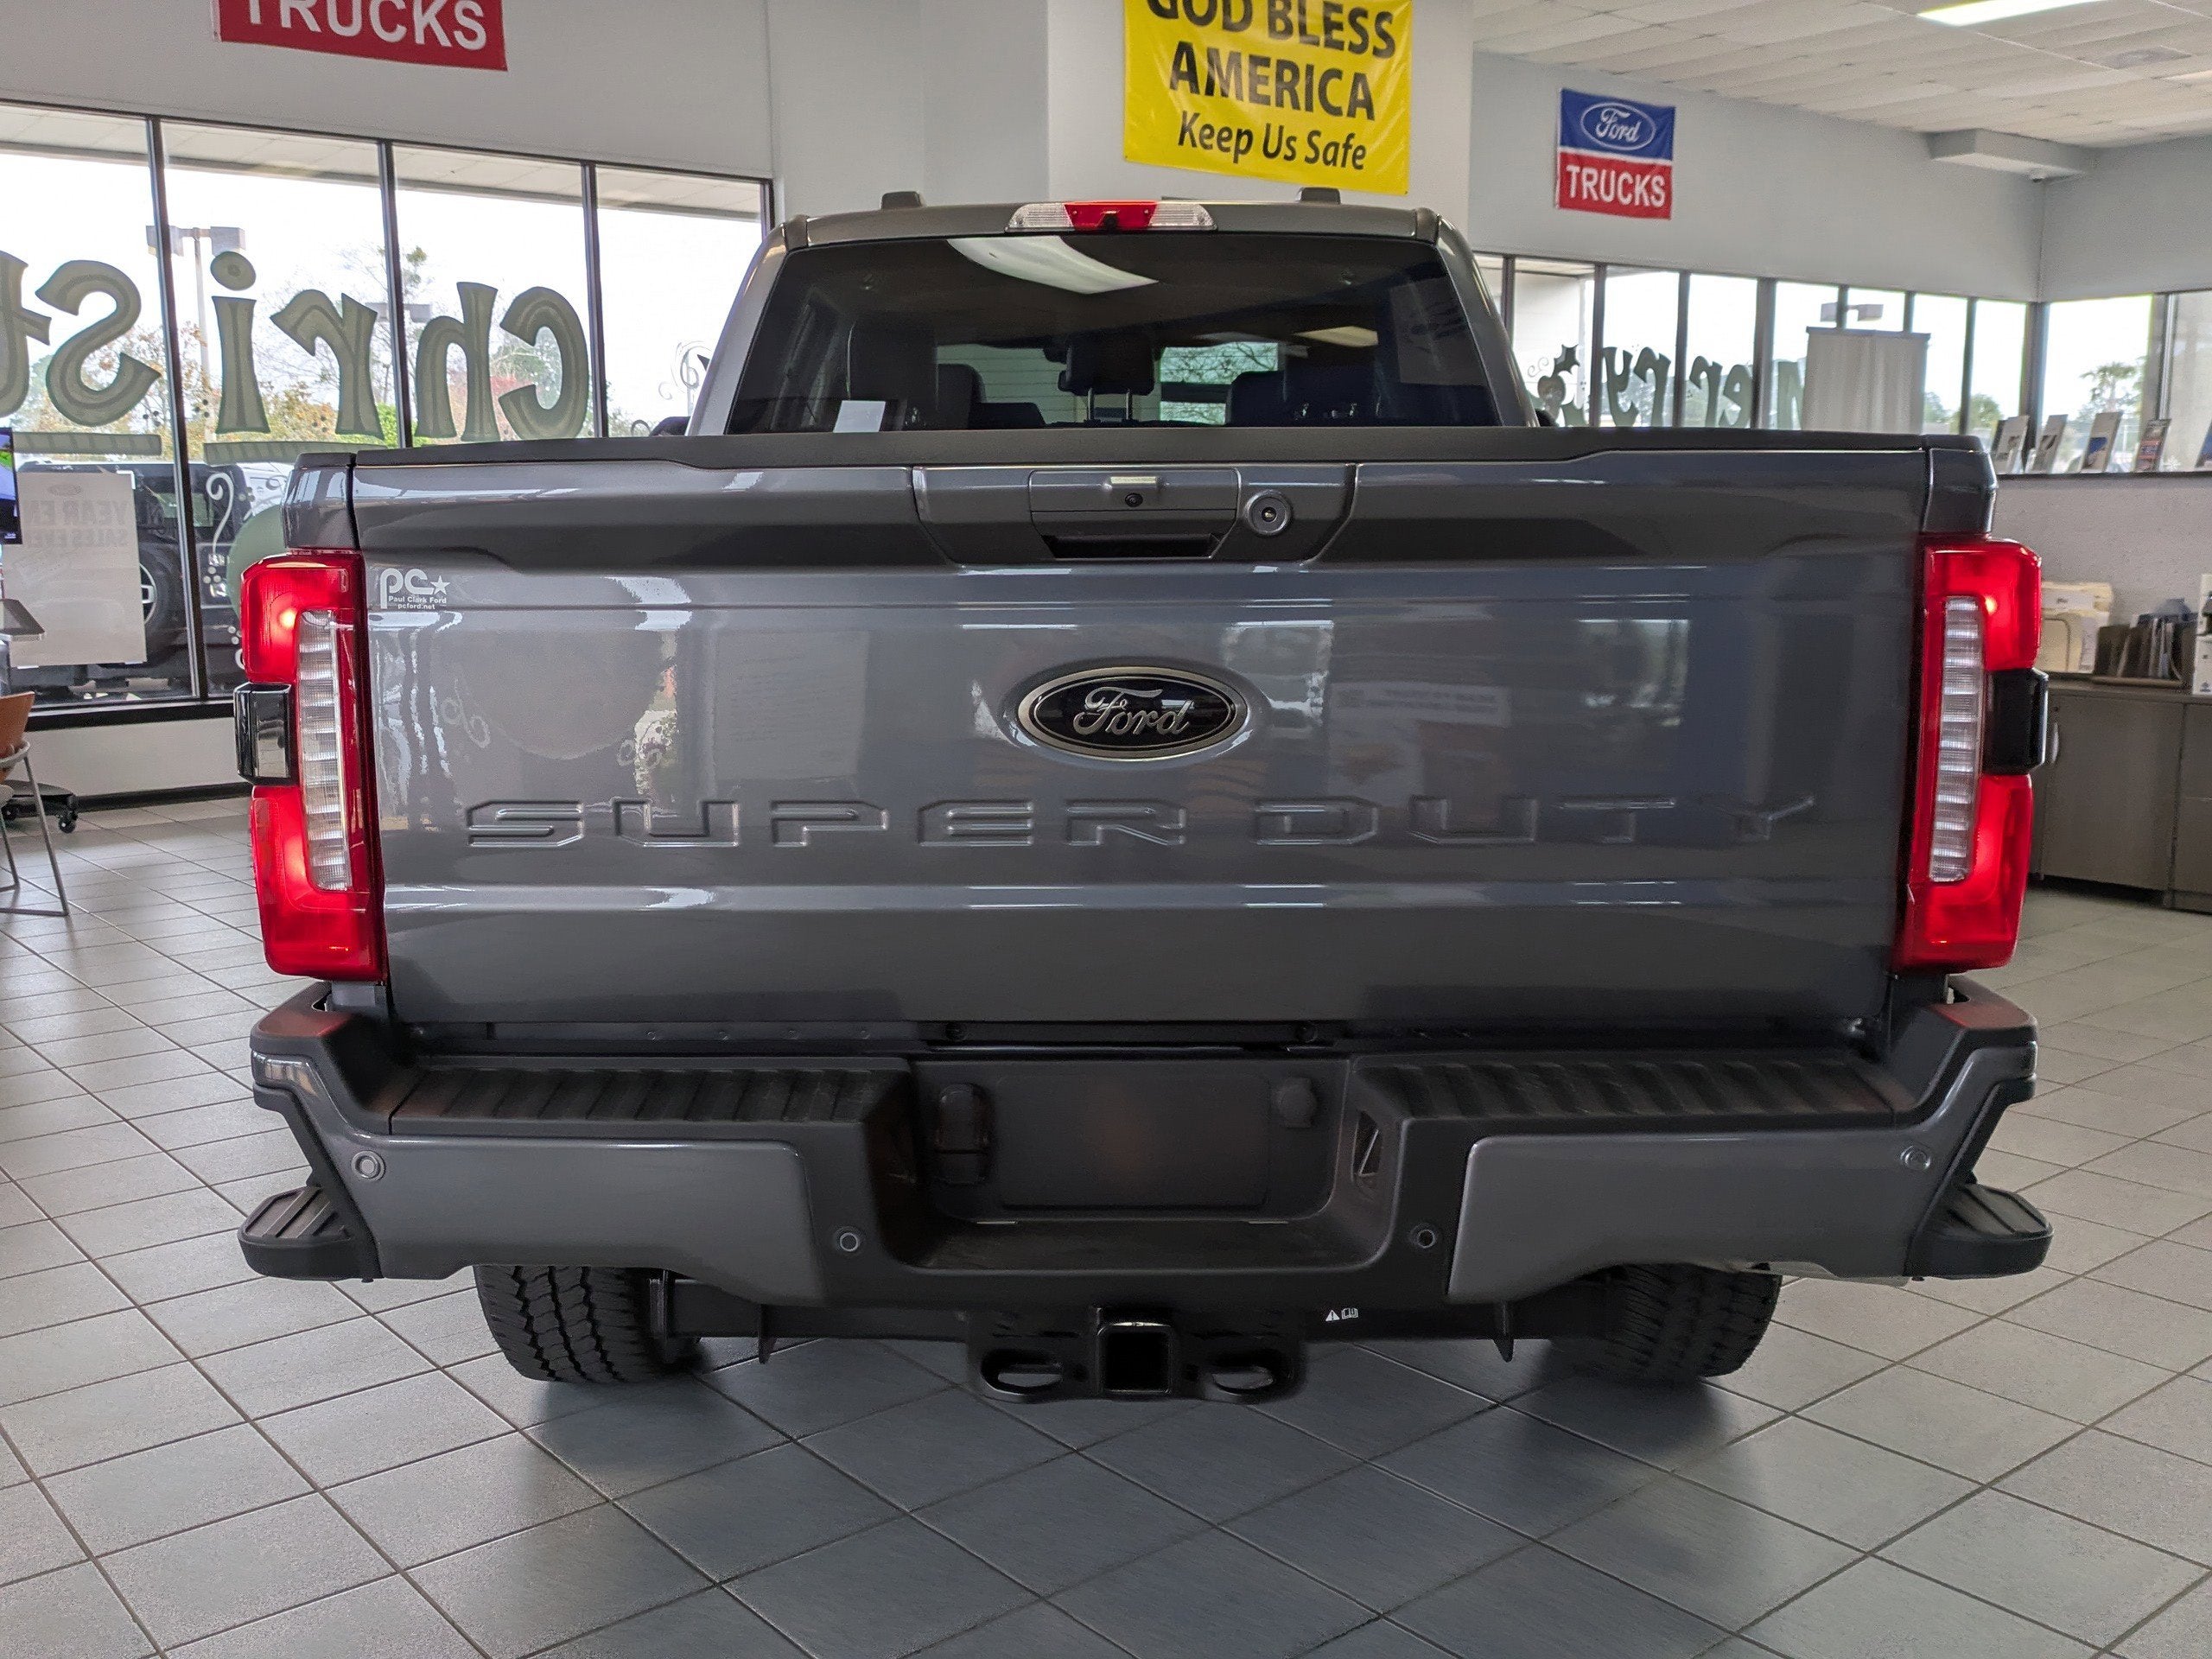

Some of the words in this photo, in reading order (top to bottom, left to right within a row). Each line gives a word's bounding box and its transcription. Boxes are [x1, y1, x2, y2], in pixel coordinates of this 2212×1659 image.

[1268, 0, 1395, 59] BLESS
[1169, 41, 1376, 121] AMERICA
[1178, 111, 1254, 163] Keep
[1262, 123, 1296, 162] Us
[1304, 130, 1367, 170] Safe
[1596, 108, 1643, 143] Ford
[1566, 164, 1666, 207] TRUCKS
[1073, 687, 1192, 735] Ford
[467, 799, 1185, 848] SUPER
[1253, 794, 1815, 846] DUTY
